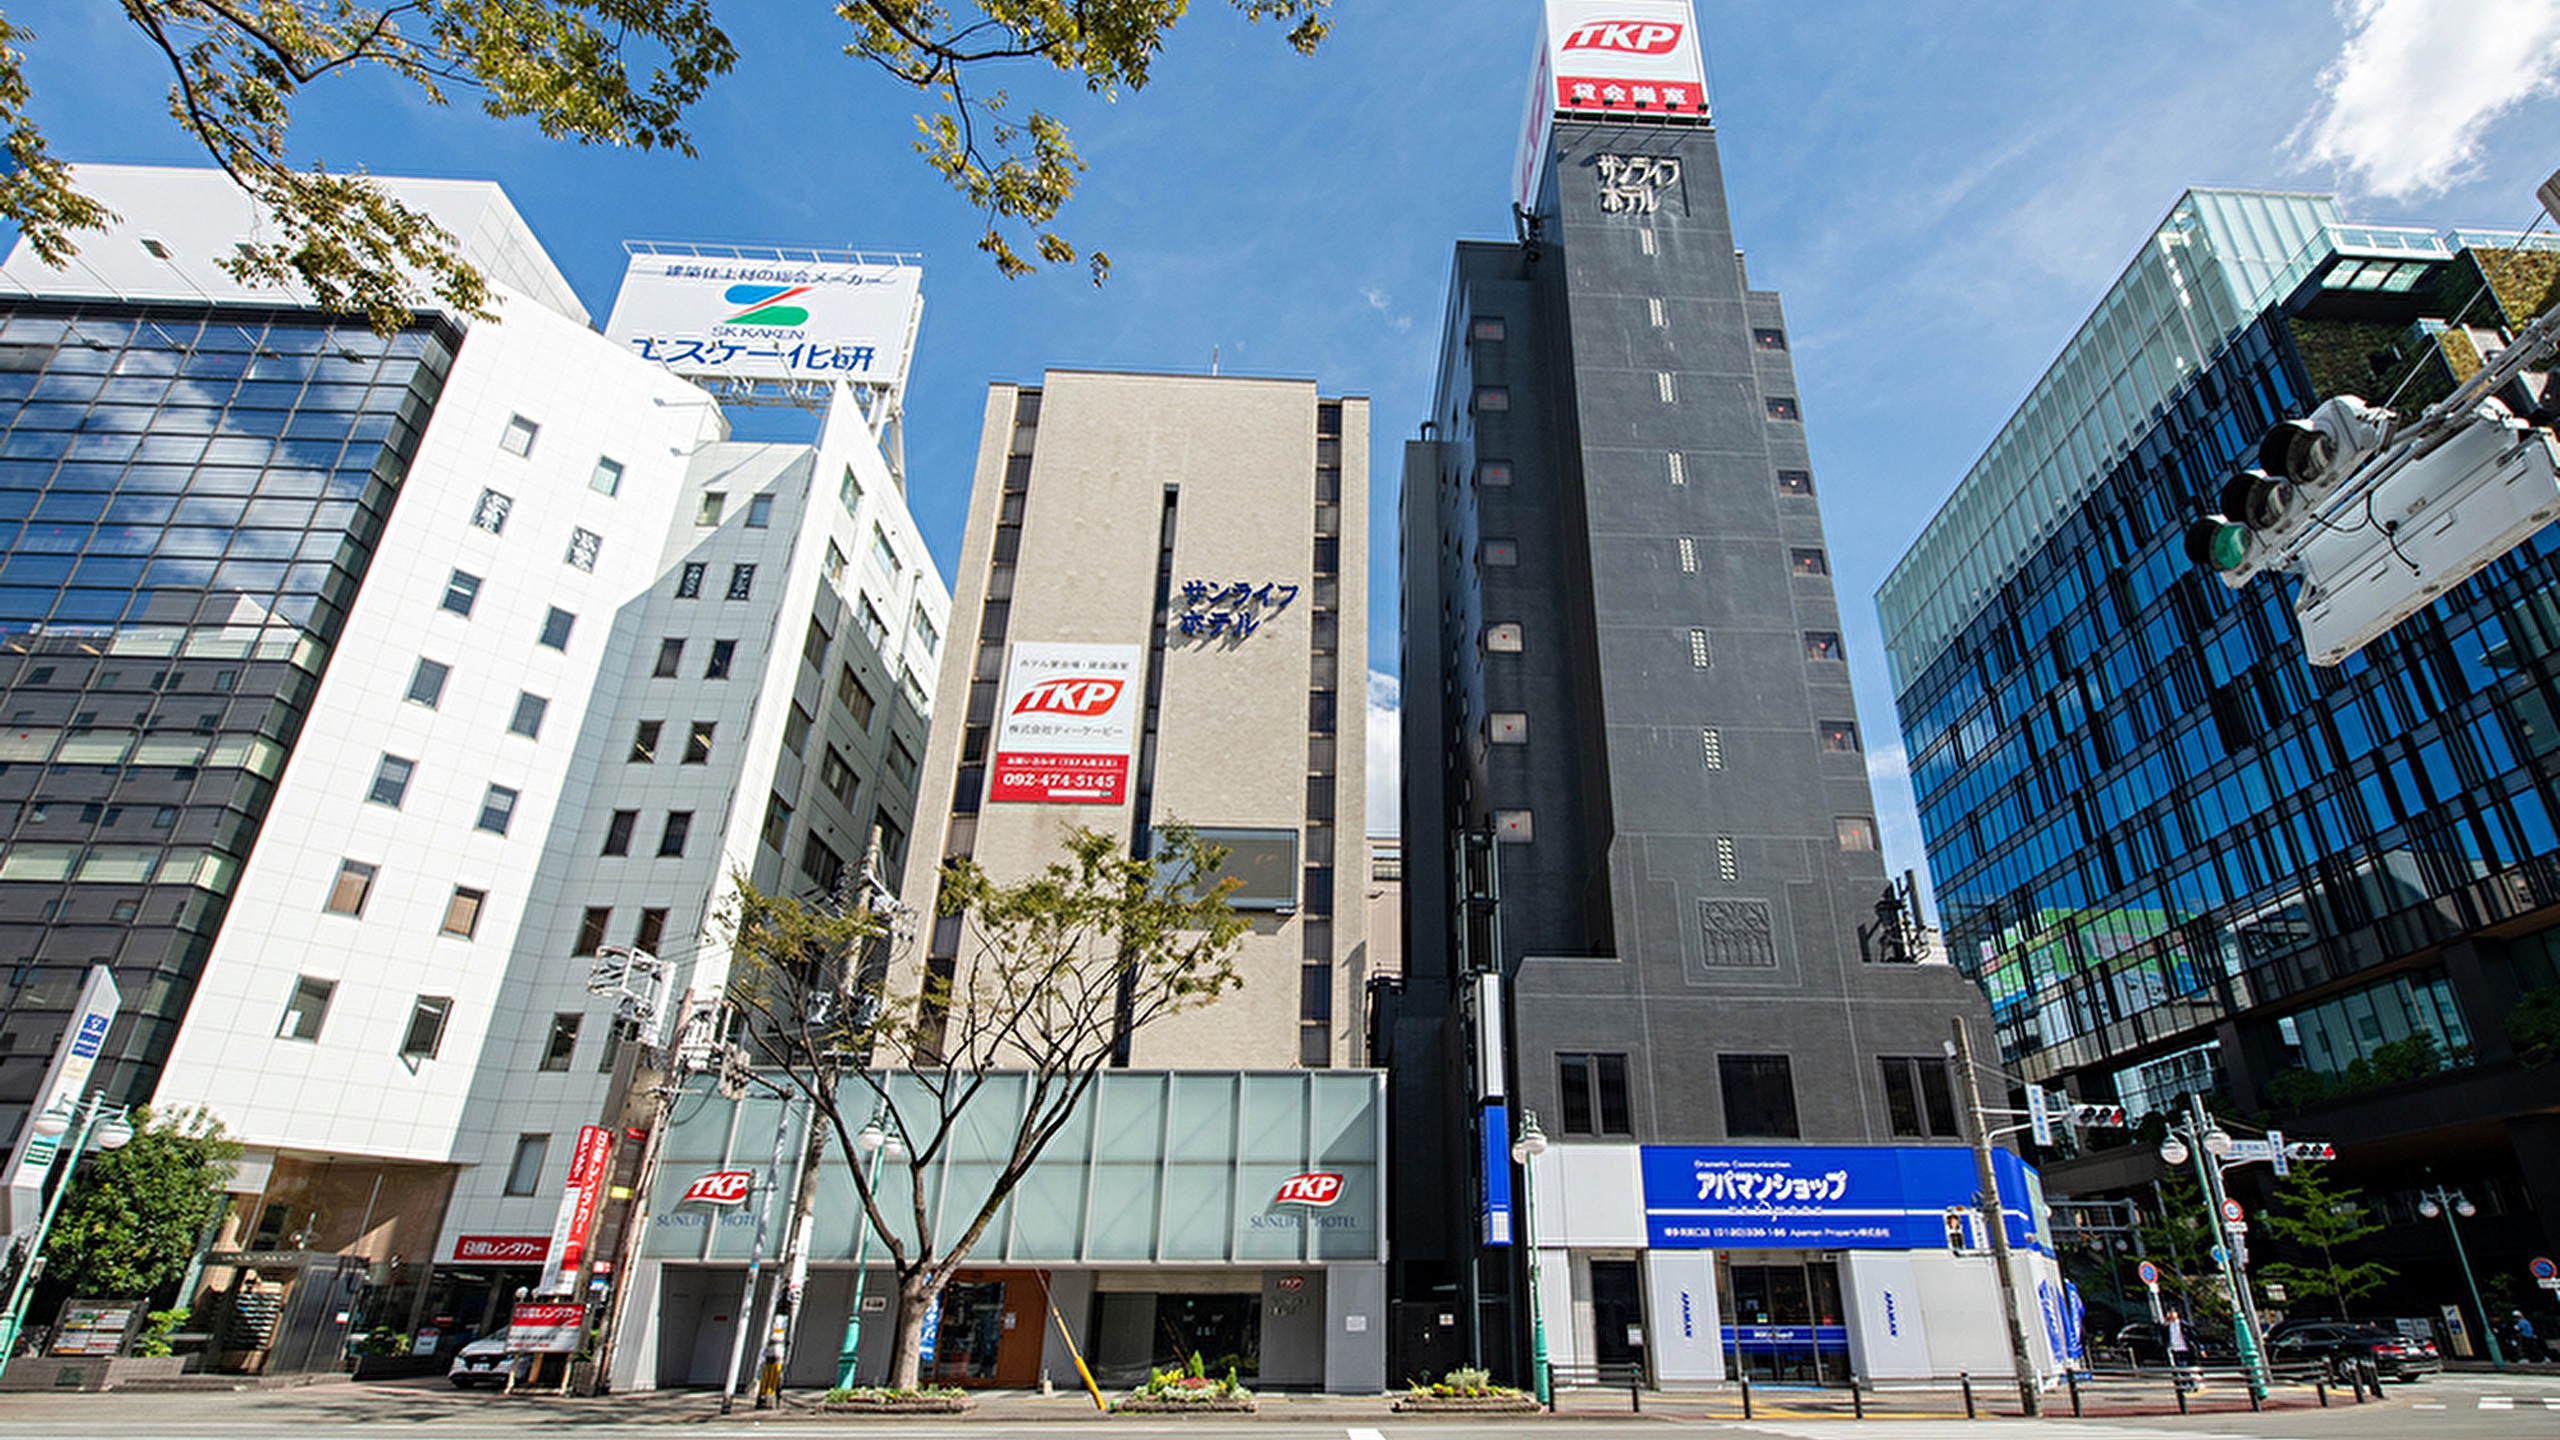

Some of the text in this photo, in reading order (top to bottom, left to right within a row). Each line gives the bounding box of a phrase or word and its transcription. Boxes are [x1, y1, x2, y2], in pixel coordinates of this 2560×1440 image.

[1568, 22, 1677, 52] TKP
[1571, 82, 1688, 105] 貸会議室
[1597, 154, 1680, 186] サンライフ
[1600, 184, 1661, 213] ホテル
[665, 264, 882, 286] 建築仕上材の総合メーカー
[739, 328, 805, 341] KAKEN
[1182, 579, 1299, 608] サンライフ
[1180, 610, 1261, 637] ホテル
[1022, 681, 1118, 713] TKP
[1003, 773, 1116, 788] 092-474-5145
[576, 1131, 608, 1234] 日産レンタカー
[688, 1174, 748, 1198] TKP
[1281, 1176, 1339, 1199] TKP
[1695, 1170, 1849, 1201] アパマンショップ
[1314, 1215, 1357, 1228] HOTEL
[462, 1240, 543, 1256] 日産レンタカー
